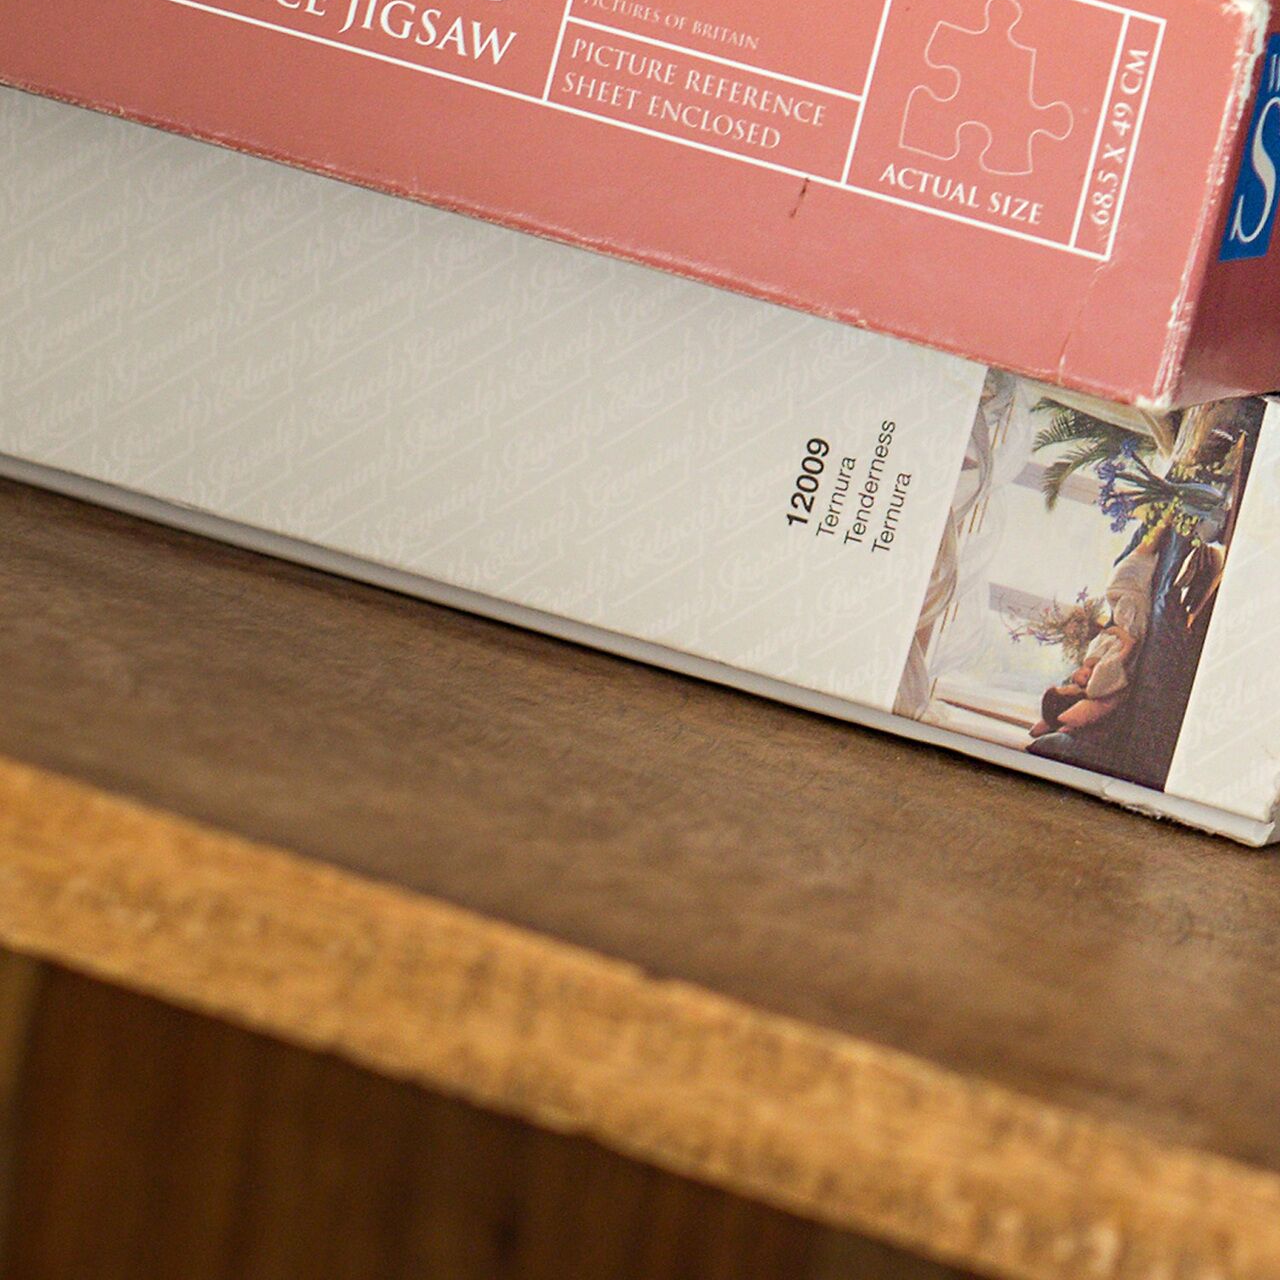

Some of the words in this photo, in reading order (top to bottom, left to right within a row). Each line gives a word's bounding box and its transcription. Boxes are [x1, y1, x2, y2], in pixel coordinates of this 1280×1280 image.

[662, 12, 688, 30] OF
[691, 20, 760, 51] BRITAIN
[1119, 47, 1150, 95] CM
[561, 71, 643, 111] SHEET
[647, 95, 782, 150] ENCLOSED
[571, 37, 678, 85] PICTURE
[684, 69, 828, 128] REFERENCE
[1112, 101, 1135, 137] 49
[878, 162, 982, 209] ACTUAL
[987, 191, 1045, 226] SIZE
[1090, 169, 1119, 226] 68.5
[785, 435, 832, 531] 12009
[815, 454, 858, 540] Ternura
[842, 418, 898, 549] Tenderness
[870, 469, 914, 555] Ternura
